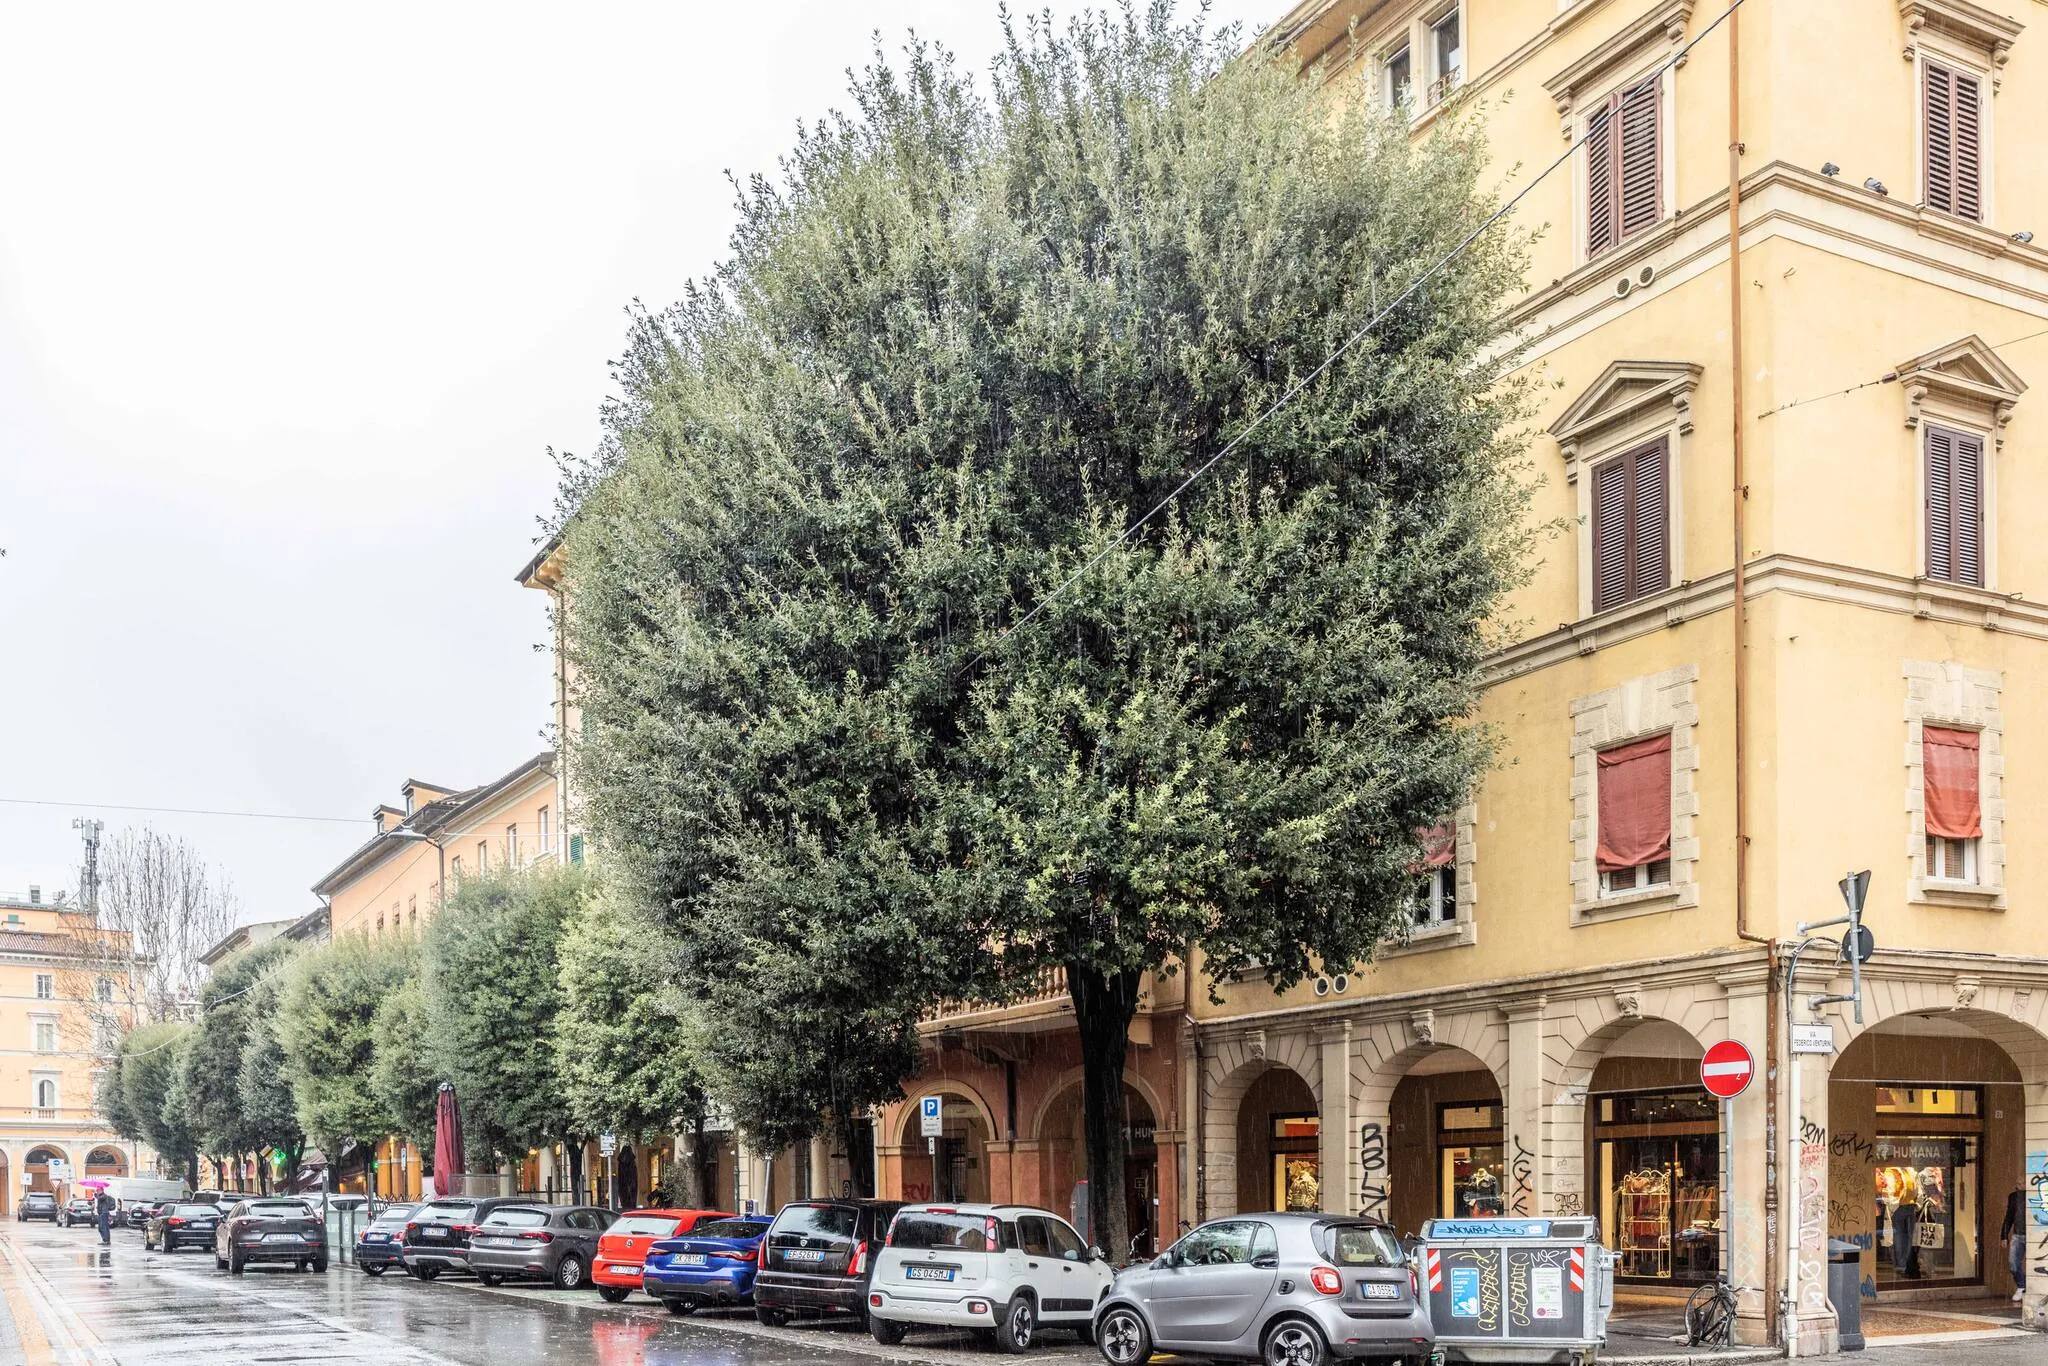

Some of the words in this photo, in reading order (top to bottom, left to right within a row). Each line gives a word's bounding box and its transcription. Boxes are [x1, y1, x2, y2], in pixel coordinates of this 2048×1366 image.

[927, 1101, 936, 1114] P
[1135, 1127, 1156, 1138] HUM
[1893, 1145, 1941, 1159] HUMANA
[1920, 1225, 1935, 1233] HU
[1920, 1232, 1935, 1240] MA
[912, 1268, 921, 1278] GS
[923, 1268, 949, 1279] 045MJ
